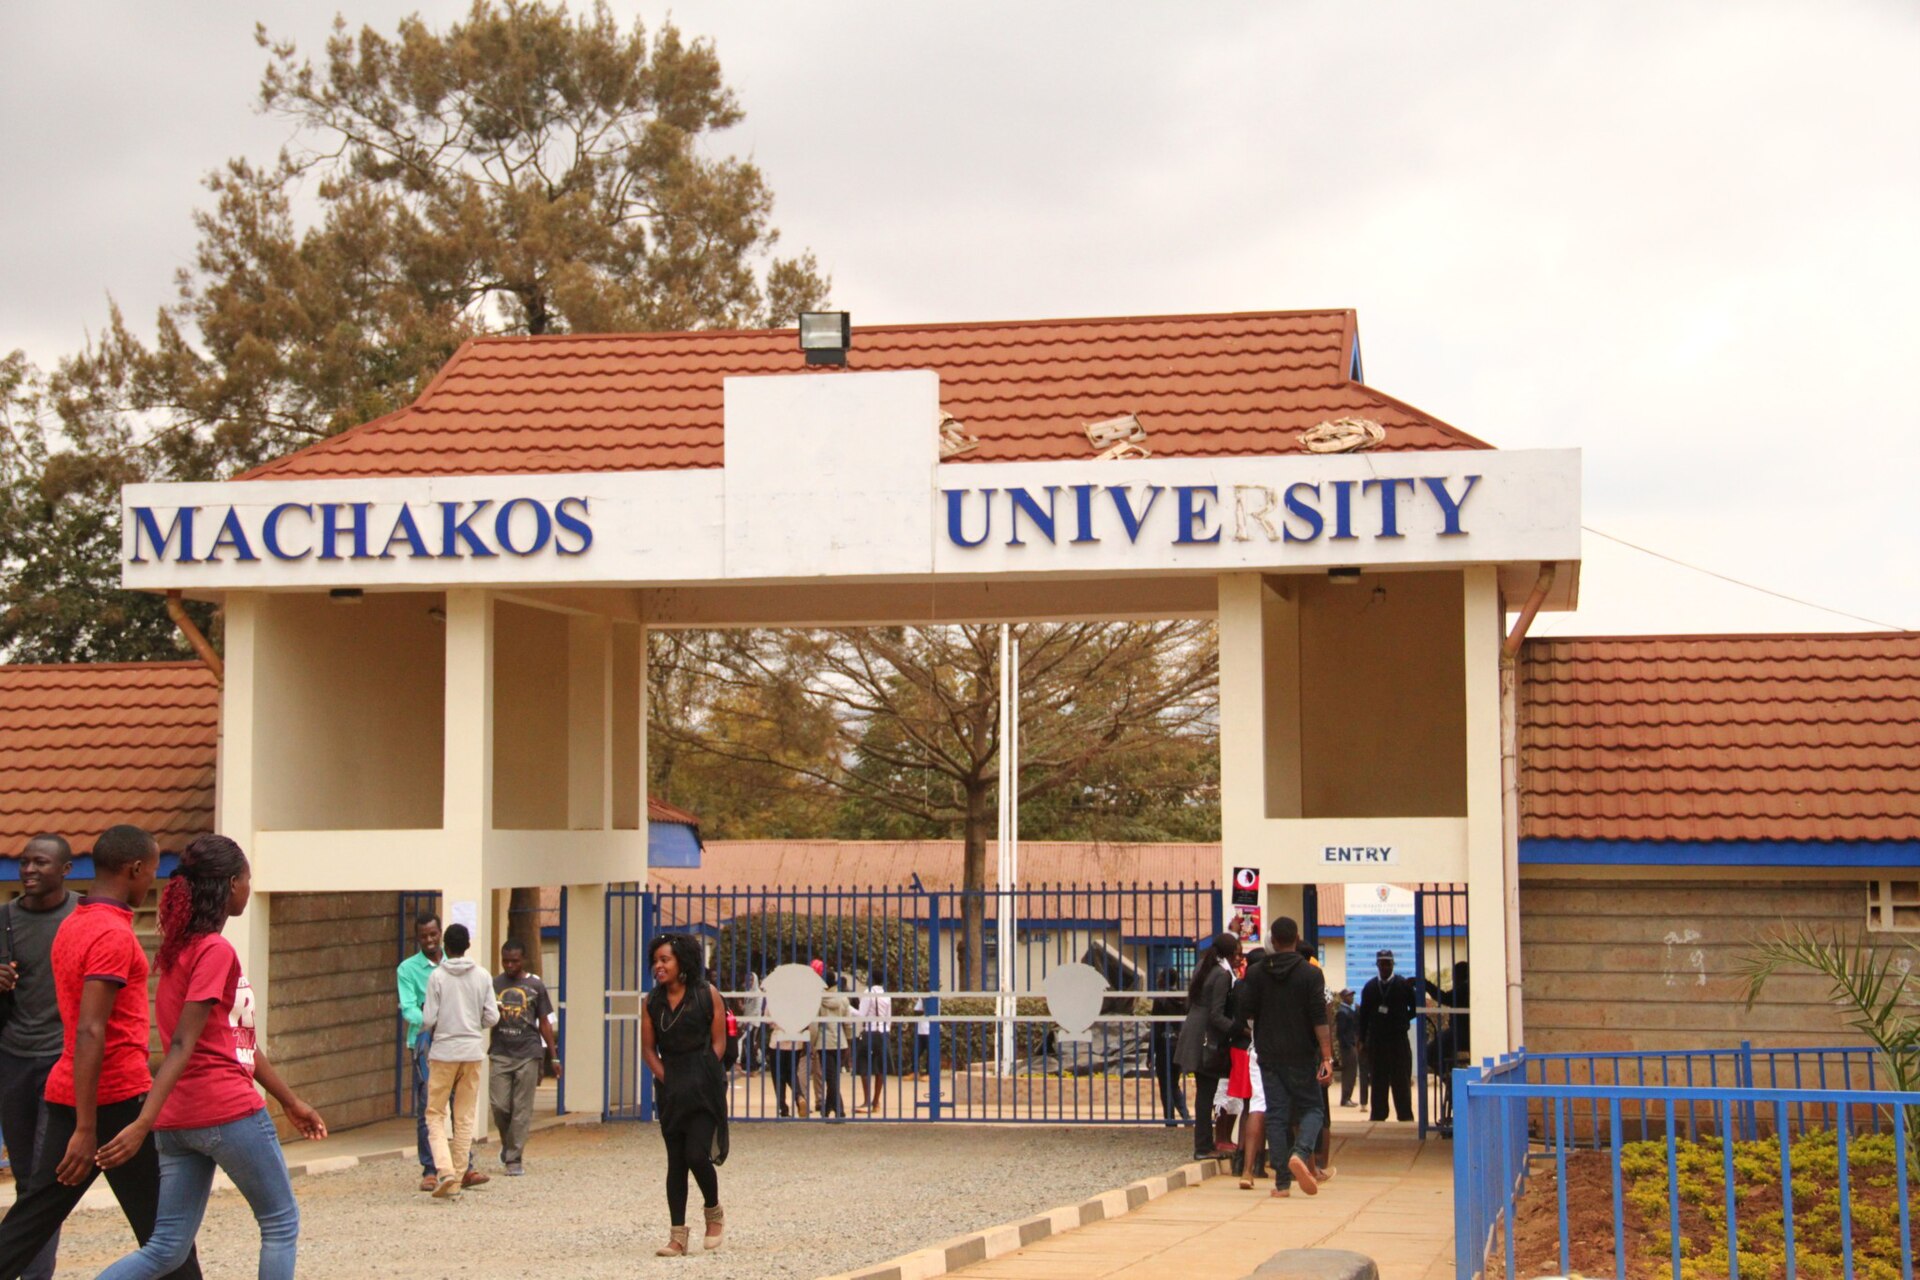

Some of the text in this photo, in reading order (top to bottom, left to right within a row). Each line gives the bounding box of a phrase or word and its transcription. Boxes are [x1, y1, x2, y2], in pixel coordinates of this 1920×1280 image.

[127, 474, 1483, 563] MACHAKOS UNIVERSITY
[1324, 846, 1392, 862] ENTRY
